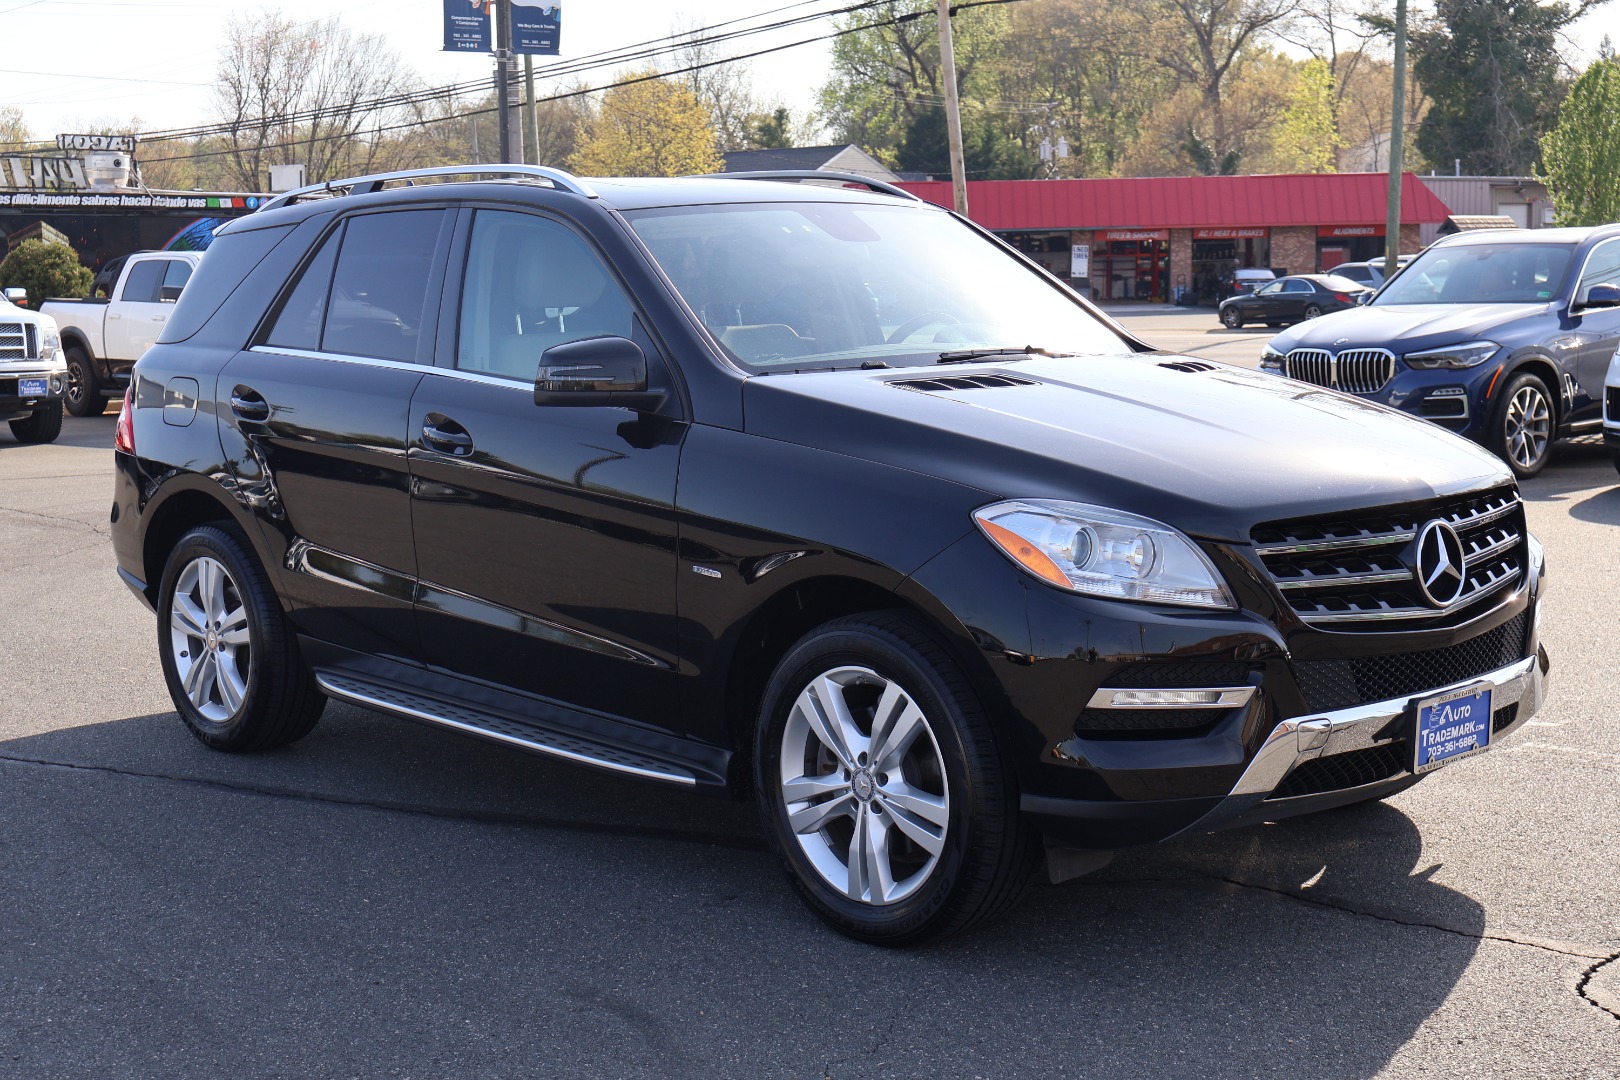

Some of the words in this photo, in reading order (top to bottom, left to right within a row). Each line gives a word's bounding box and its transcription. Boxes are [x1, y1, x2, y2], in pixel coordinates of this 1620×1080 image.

[81, 195, 120, 206] sabras
[120, 195, 150, 206] hacia
[188, 198, 206, 207] vas
[1428, 734, 1477, 758] 703-361-6882
